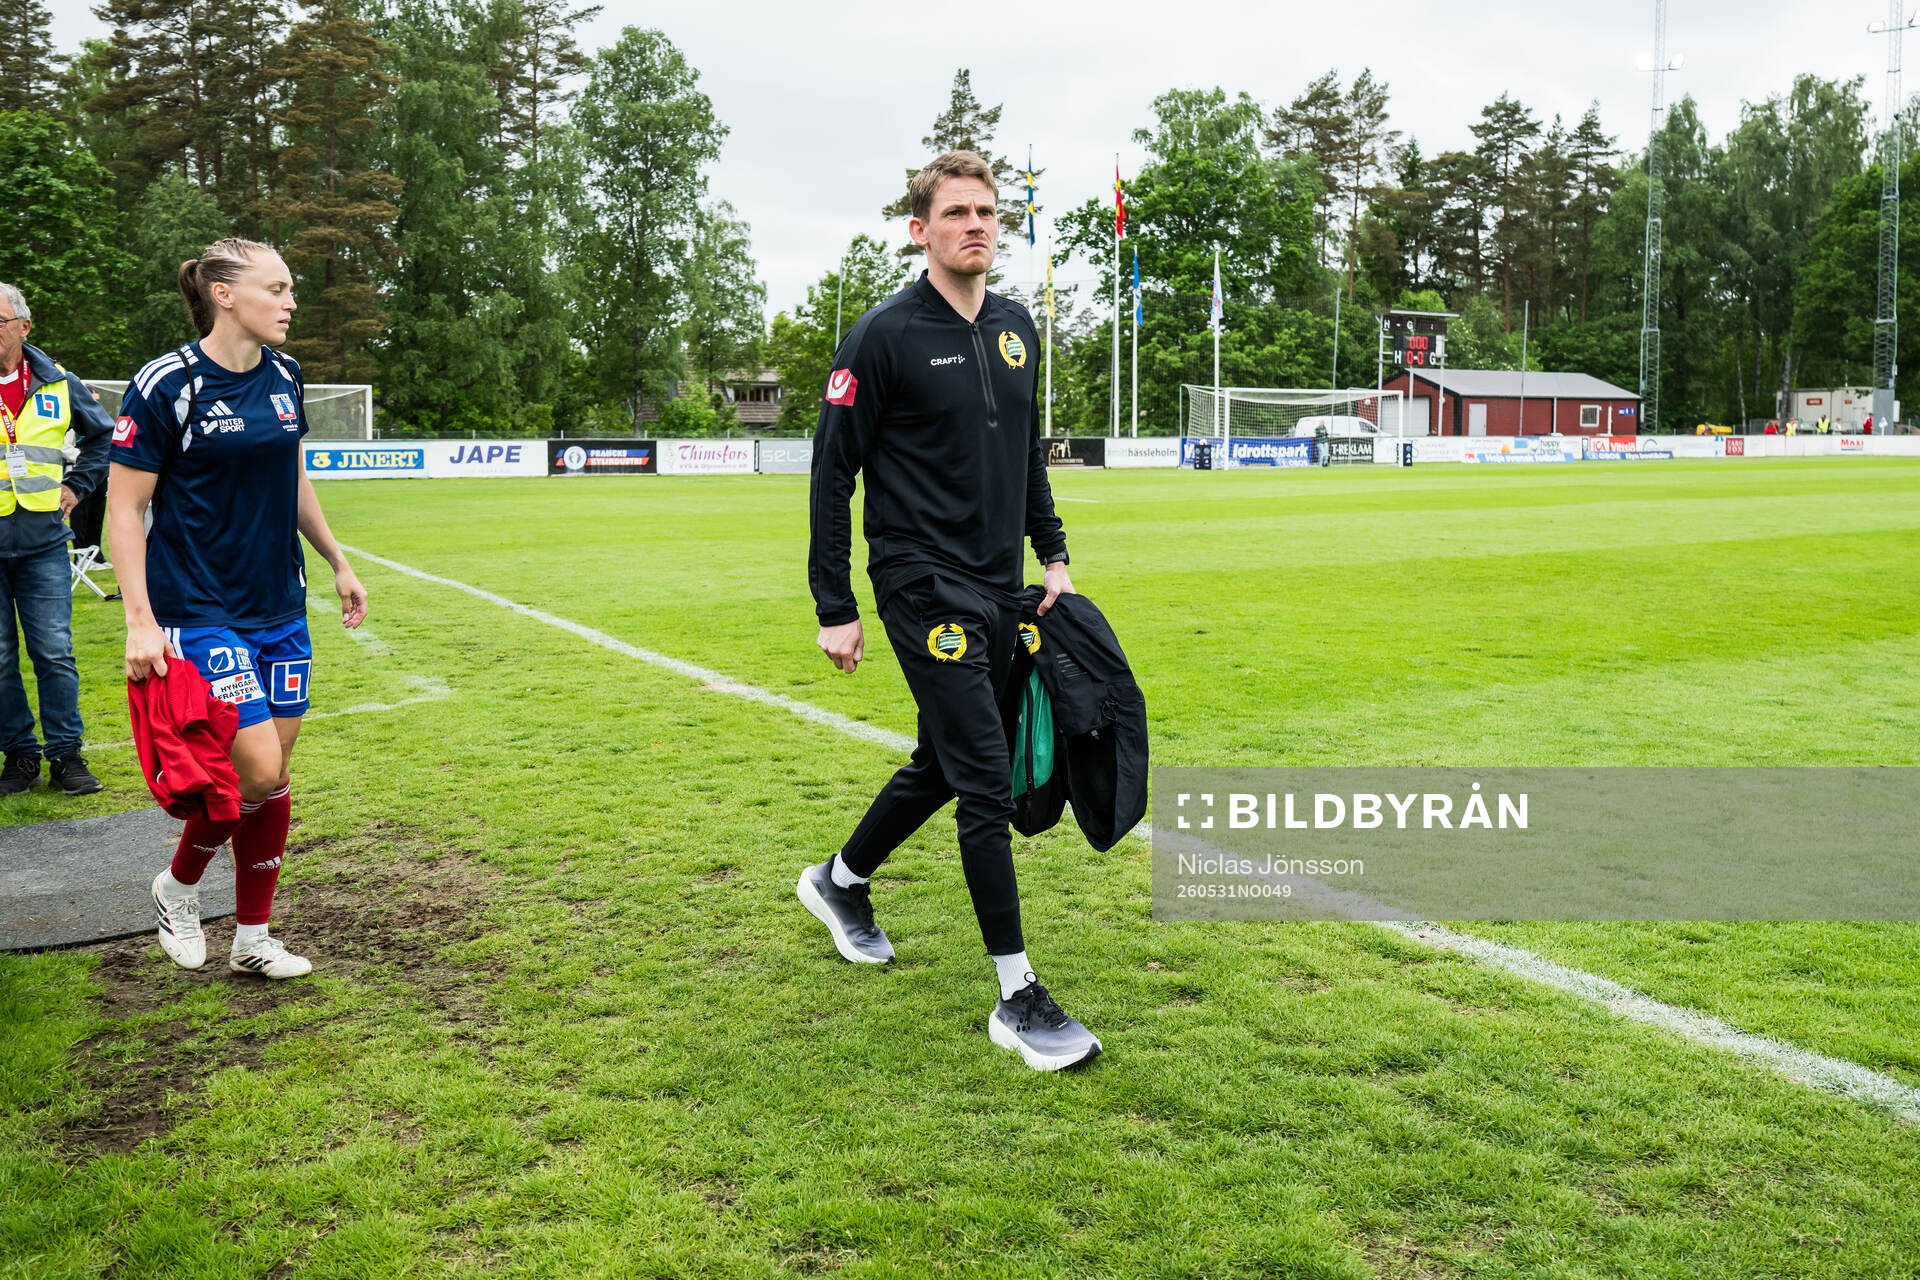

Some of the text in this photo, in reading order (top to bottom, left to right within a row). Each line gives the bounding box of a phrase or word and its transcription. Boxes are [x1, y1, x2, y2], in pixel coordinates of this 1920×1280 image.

[930, 356, 957, 366] CRAFT
[219, 418, 244, 426] INTER
[219, 425, 245, 433] SPORT
[449, 445, 523, 464] JAPE
[1232, 443, 1309, 459] Idrottspark
[1331, 443, 1373, 455] T-REKLAM
[336, 451, 419, 469] JINERT
